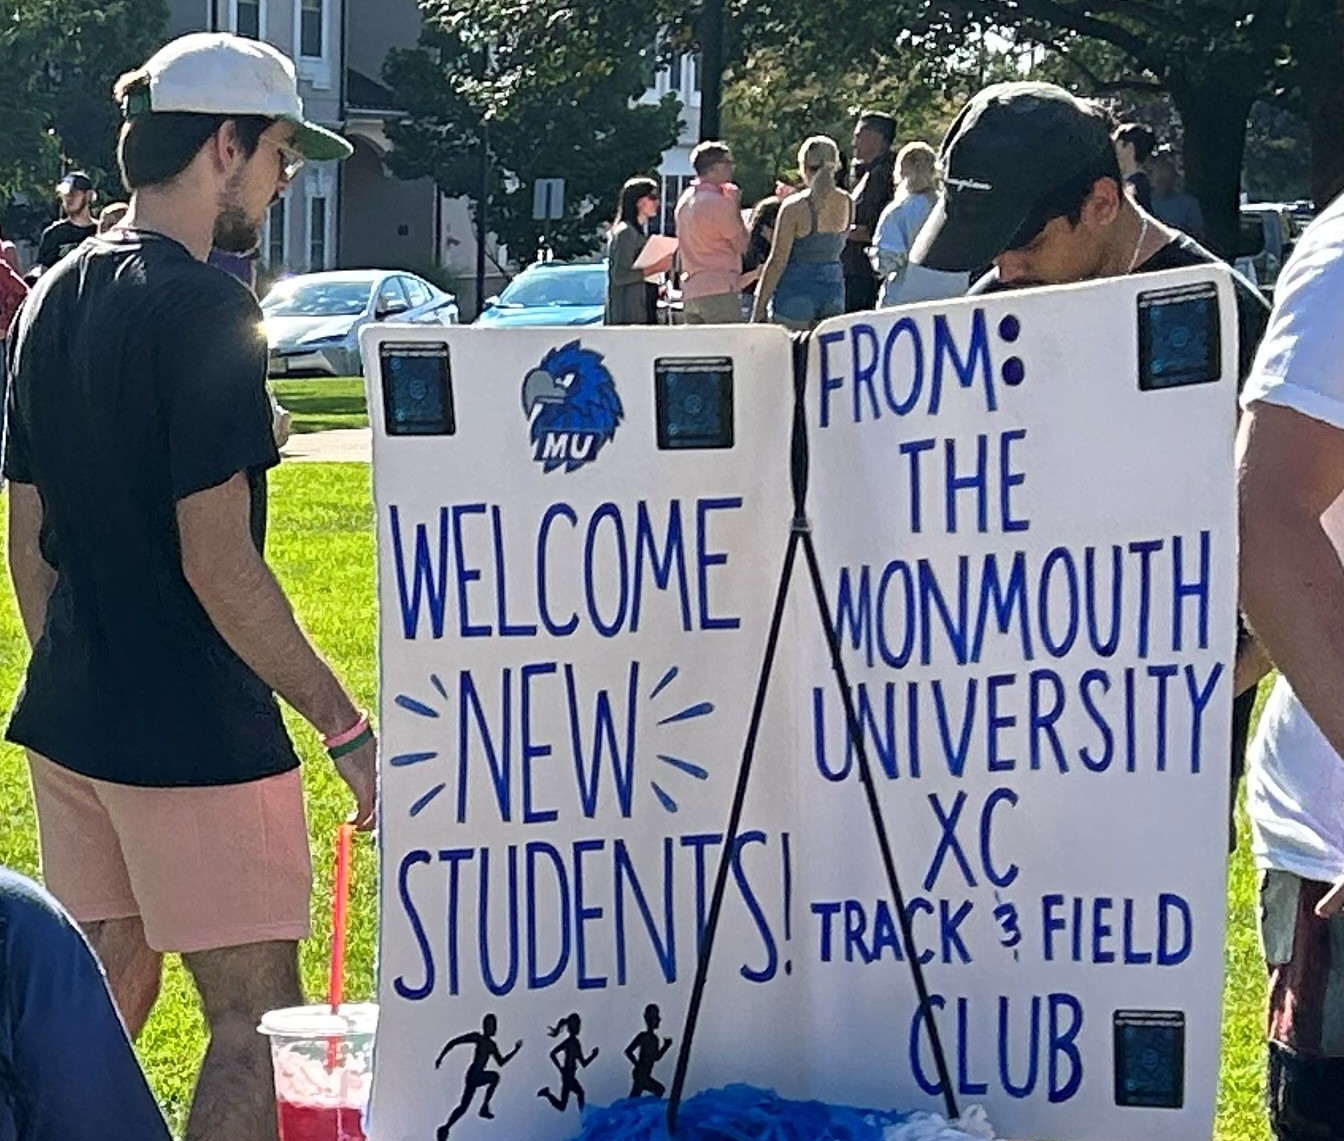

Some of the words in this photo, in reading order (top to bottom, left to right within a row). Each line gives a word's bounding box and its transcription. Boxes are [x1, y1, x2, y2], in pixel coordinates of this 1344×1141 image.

[818, 311, 1023, 428] FROM:
[542, 432, 594, 460] MU
[899, 430, 1030, 535] THE
[389, 497, 743, 640] WELCOME
[834, 530, 1211, 671] MONMOUTH
[457, 661, 639, 825] NEW
[810, 662, 1226, 783] UNIVERSITY
[924, 789, 1020, 891] XC
[394, 830, 792, 1000] STUDENTS!
[810, 895, 973, 965] TRACK
[1042, 894, 1194, 966] FIELD
[909, 993, 1084, 1102] CLUB
